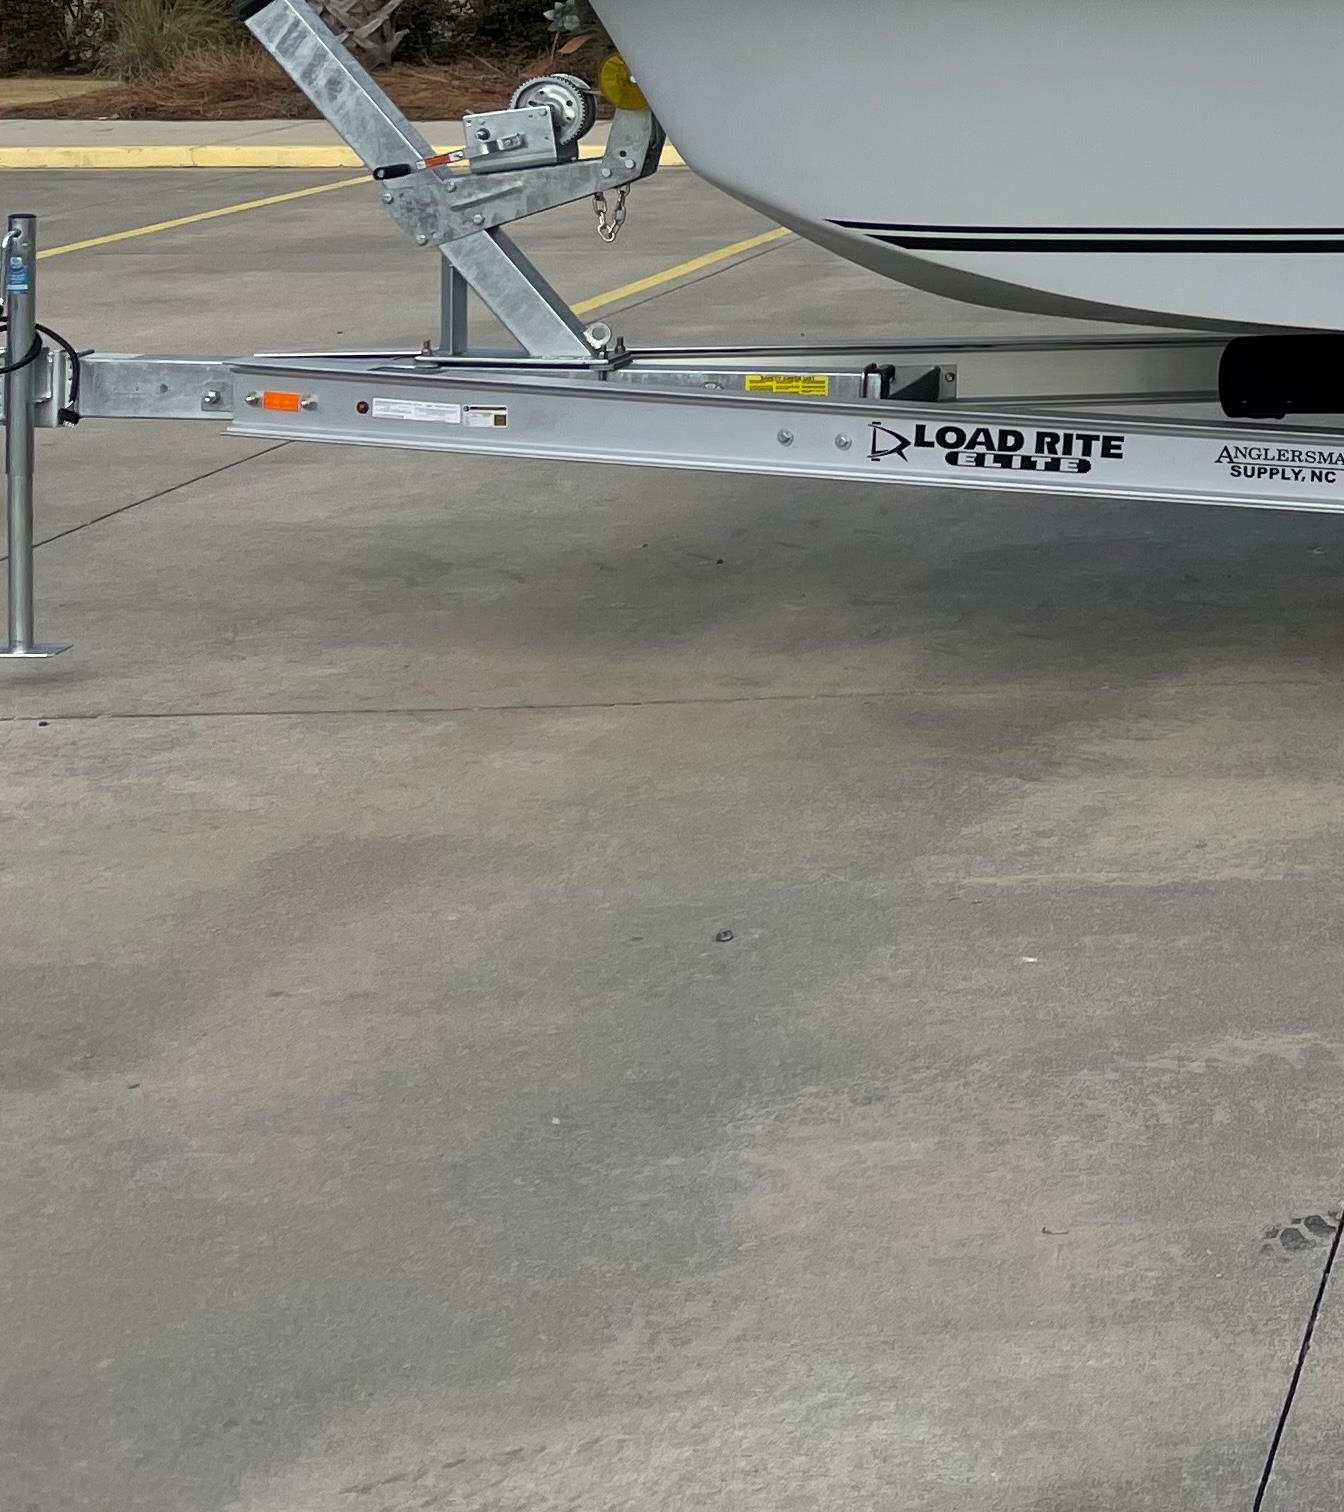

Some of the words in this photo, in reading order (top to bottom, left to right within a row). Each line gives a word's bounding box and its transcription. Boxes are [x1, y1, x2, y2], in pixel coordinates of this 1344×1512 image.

[914, 424, 1024, 452] LOAD
[1035, 431, 1125, 459] RITE
[956, 453, 1080, 472] ELITE
[1230, 465, 1305, 482] SUPPLY,
[1310, 469, 1336, 483] NC
